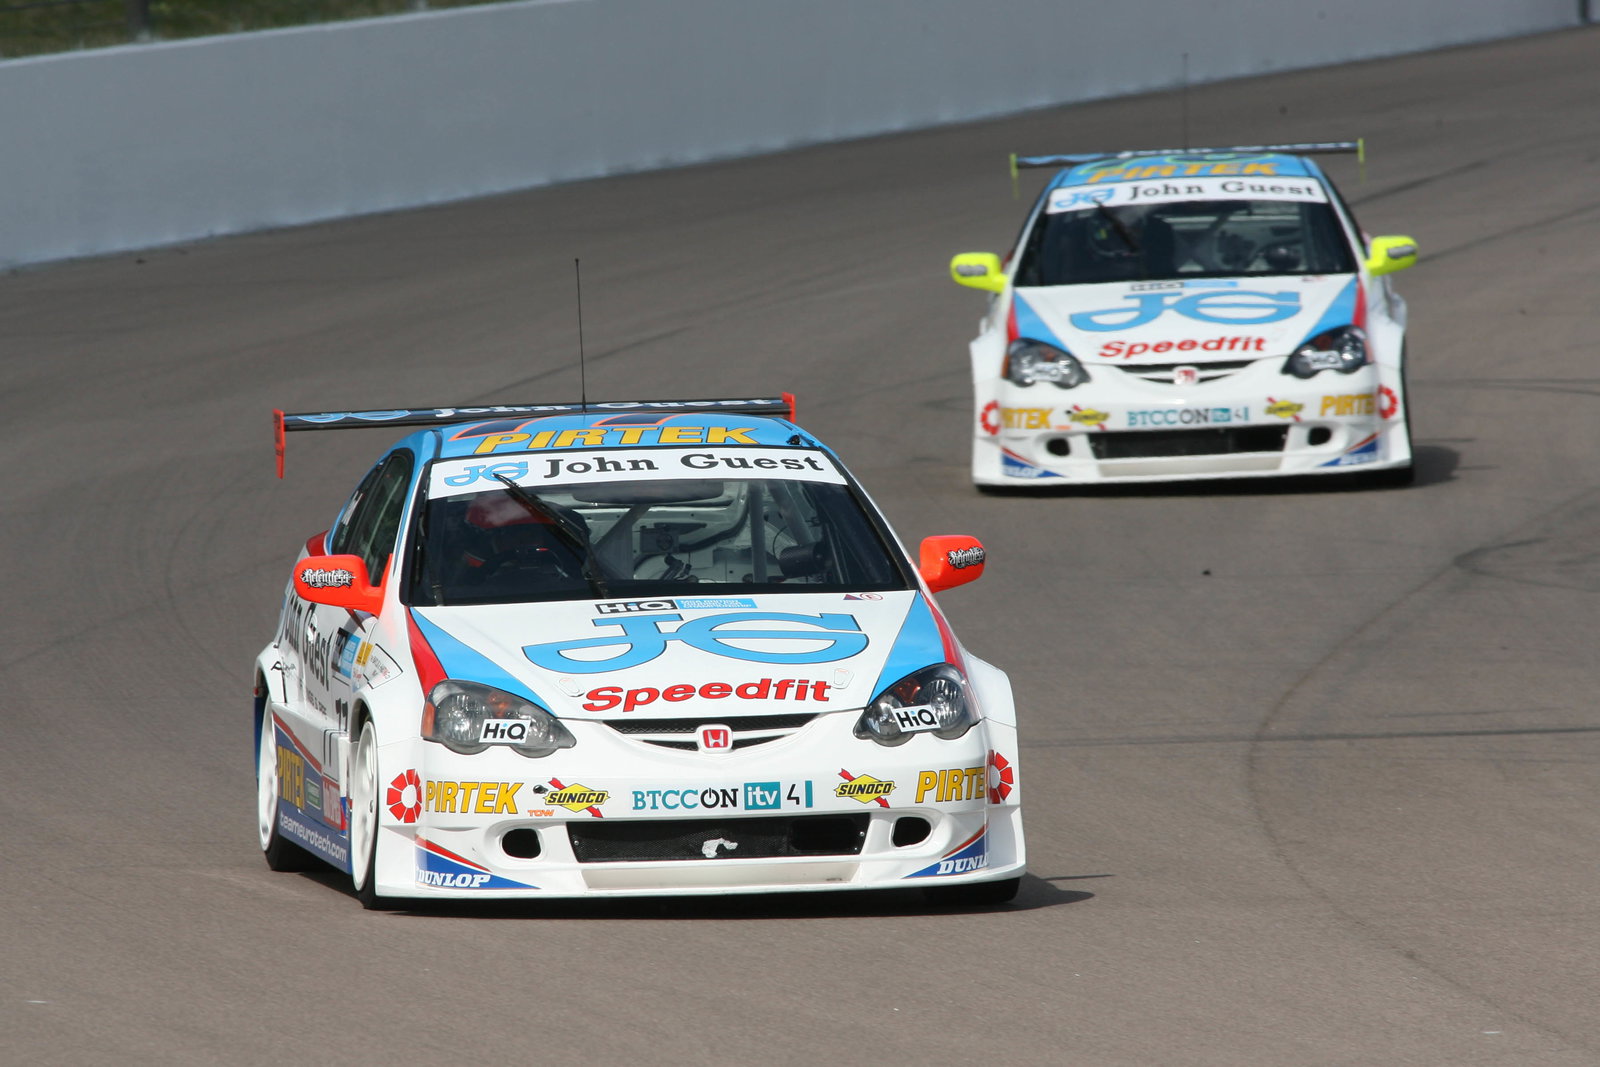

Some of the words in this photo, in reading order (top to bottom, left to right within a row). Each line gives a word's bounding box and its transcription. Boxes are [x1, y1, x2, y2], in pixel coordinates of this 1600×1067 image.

[1129, 183, 1205, 200] John
[1221, 180, 1315, 197] Guest
[1098, 336, 1267, 359] Speedfit
[472, 427, 760, 454] PIRTEK
[543, 457, 660, 479] John
[680, 453, 825, 471] Guest
[599, 600, 676, 614] HiQ
[582, 678, 832, 712] Speedfit
[895, 710, 938, 729] HiQ
[482, 722, 527, 741] HiQ
[838, 782, 893, 797] SUNOCO
[915, 766, 986, 804] PIRTE
[425, 780, 525, 815] PIRTEK
[547, 792, 608, 805] SUNOCO
[418, 868, 491, 888] DUNLOP
